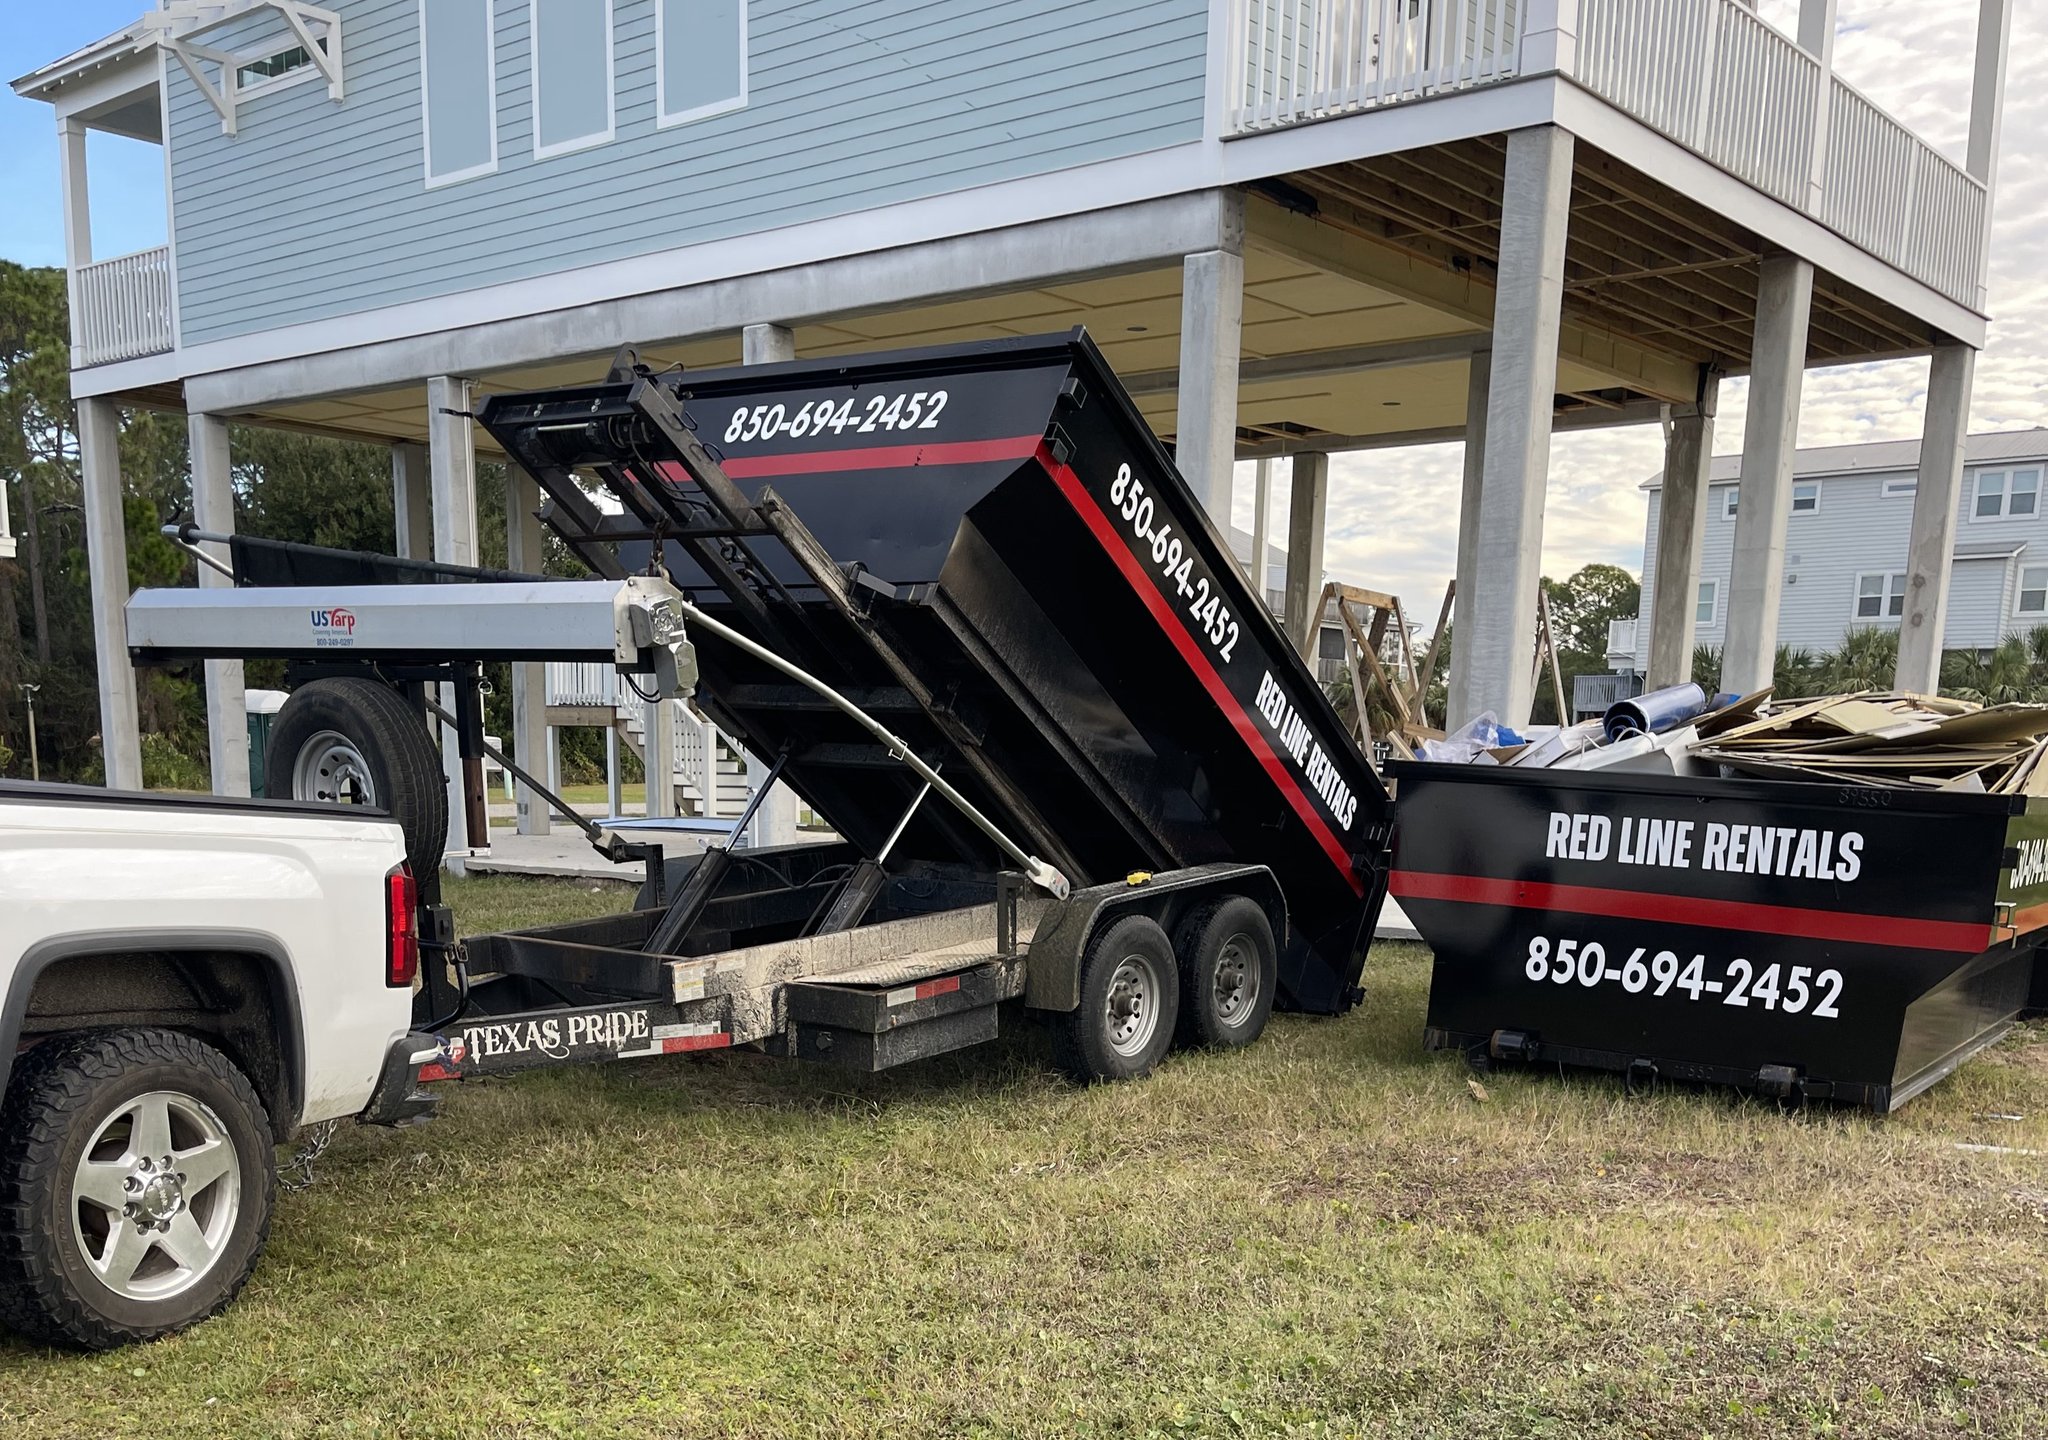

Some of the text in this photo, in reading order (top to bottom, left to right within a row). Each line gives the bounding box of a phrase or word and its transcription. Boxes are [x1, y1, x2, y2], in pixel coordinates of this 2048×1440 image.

[724, 390, 948, 444] 850-694-2452
[1110, 463, 1239, 664] 850-694-2452
[1255, 669, 1357, 831] RED LINE RENTALS
[1545, 812, 1865, 882] RED LINE RENTALS
[1525, 936, 1843, 1018] 850-694-2452
[463, 1010, 649, 1065] TEXAS PRIDE
